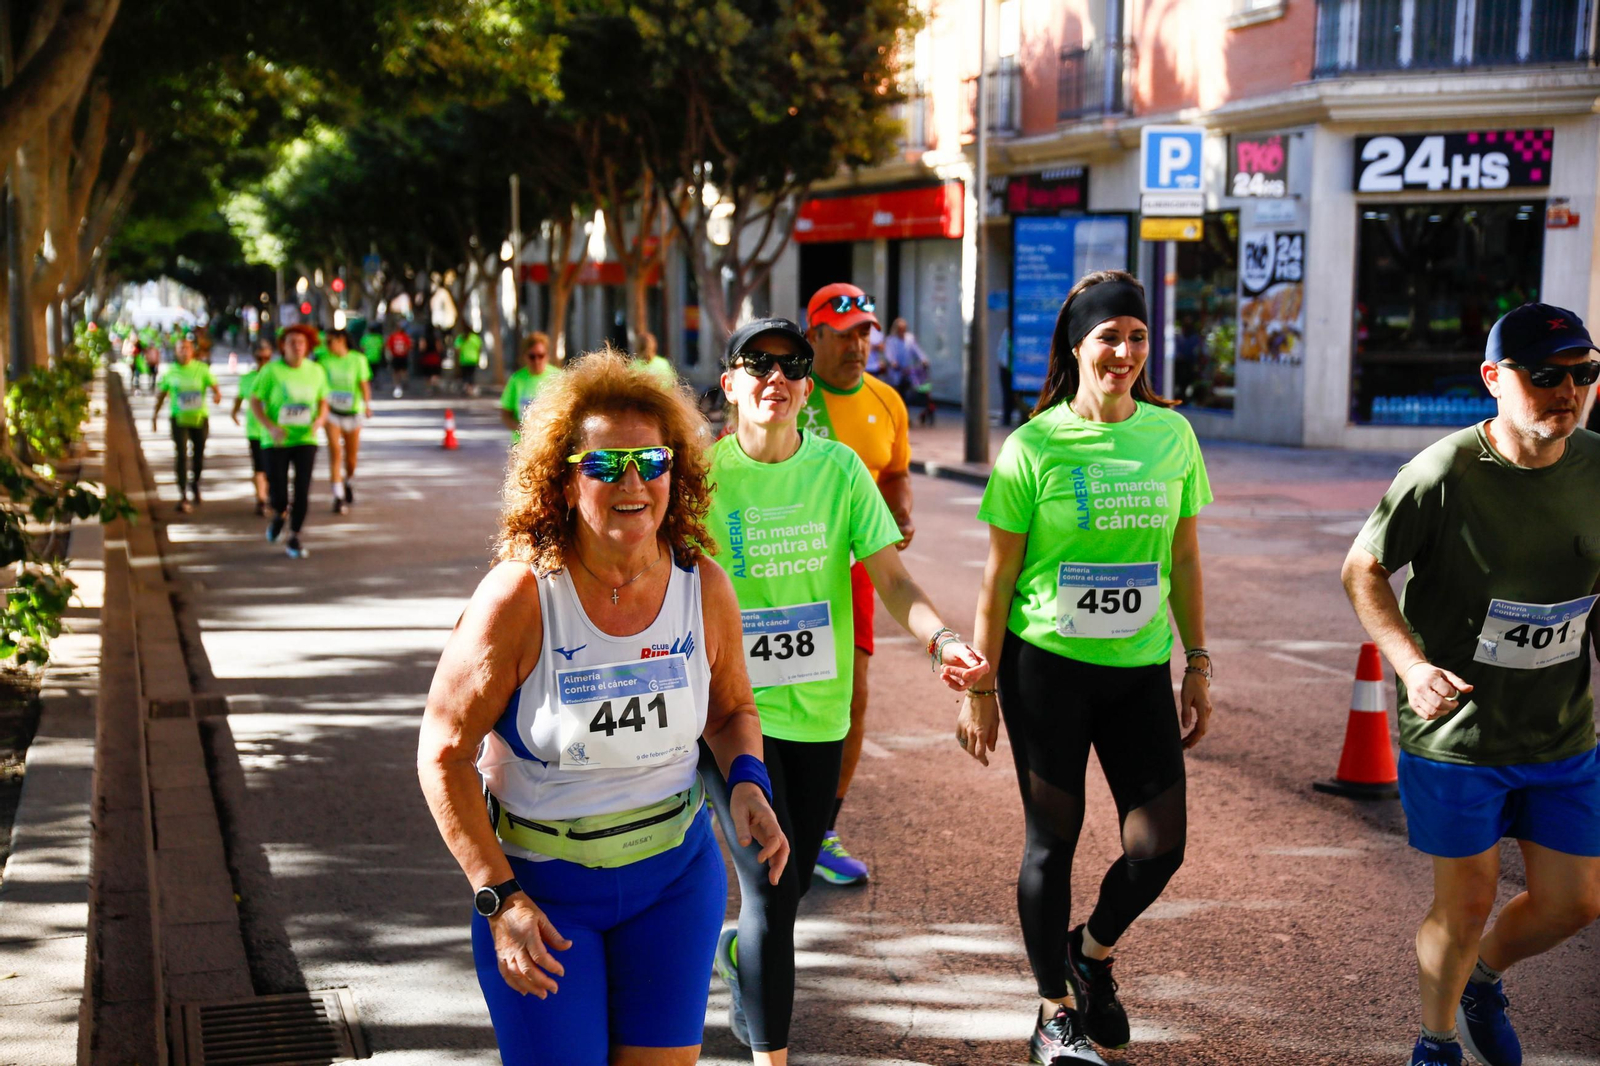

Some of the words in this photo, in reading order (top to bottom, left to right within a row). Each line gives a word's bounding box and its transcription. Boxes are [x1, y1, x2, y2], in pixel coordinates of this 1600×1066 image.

[1158, 137, 1192, 187] P
[1091, 481, 1111, 494] En
[1114, 479, 1167, 492] marcha
[1069, 466, 1090, 531] ALMERÍA
[1094, 494, 1151, 509] contra
[1155, 492, 1169, 507] el
[1095, 510, 1169, 530] cáncer
[746, 527, 766, 541] En
[770, 521, 827, 538] marcha
[725, 509, 747, 579] ALMERÍA
[748, 539, 808, 557] contra
[812, 533, 828, 549] el
[750, 555, 828, 578] cáncer
[1063, 566, 1090, 574] Almería
[1077, 588, 1142, 614] 450
[1495, 602, 1527, 612] Almería
[757, 620, 765, 628] el
[765, 619, 790, 627] cáncer
[1494, 608, 1520, 617] contra
[1532, 613, 1557, 621] cáncer
[1504, 620, 1571, 650] 401
[749, 630, 815, 661] 438
[563, 672, 601, 684] Almería
[564, 684, 596, 695] contra
[598, 680, 606, 690] el
[607, 678, 638, 688] cáncer
[589, 692, 668, 737] 441
